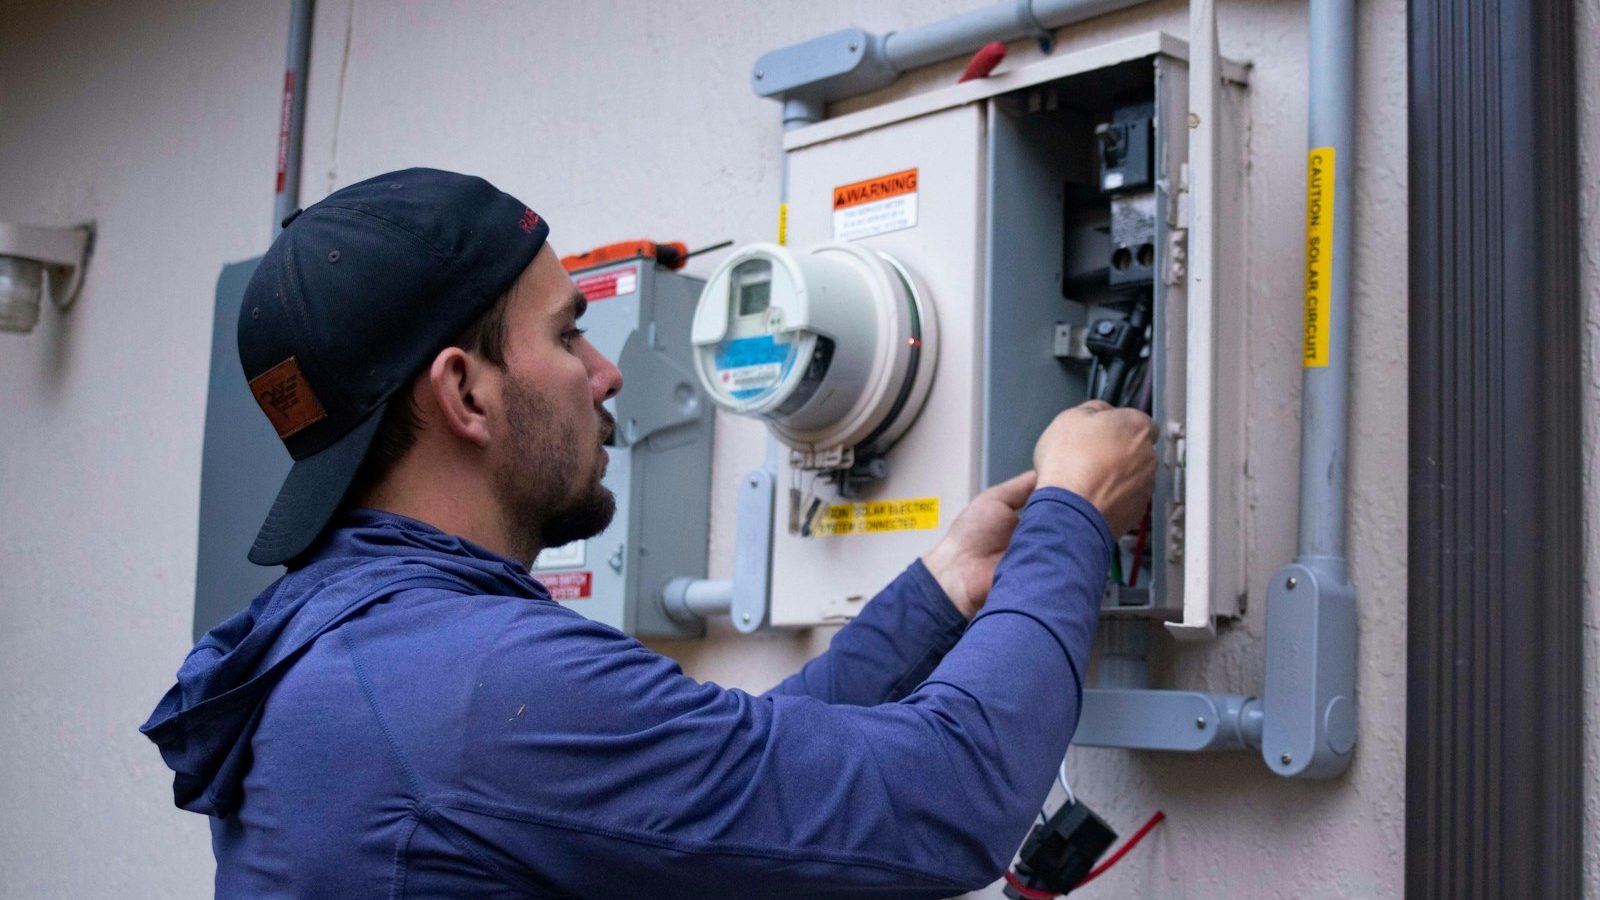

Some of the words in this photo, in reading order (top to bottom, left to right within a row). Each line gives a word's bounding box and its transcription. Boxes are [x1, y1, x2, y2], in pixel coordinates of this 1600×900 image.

[846, 174, 917, 203] WARNING
[1308, 236, 1321, 292] SOLAR
[1305, 295, 1319, 361] CIRCUIT
[888, 501, 936, 514] ELECTRIC
